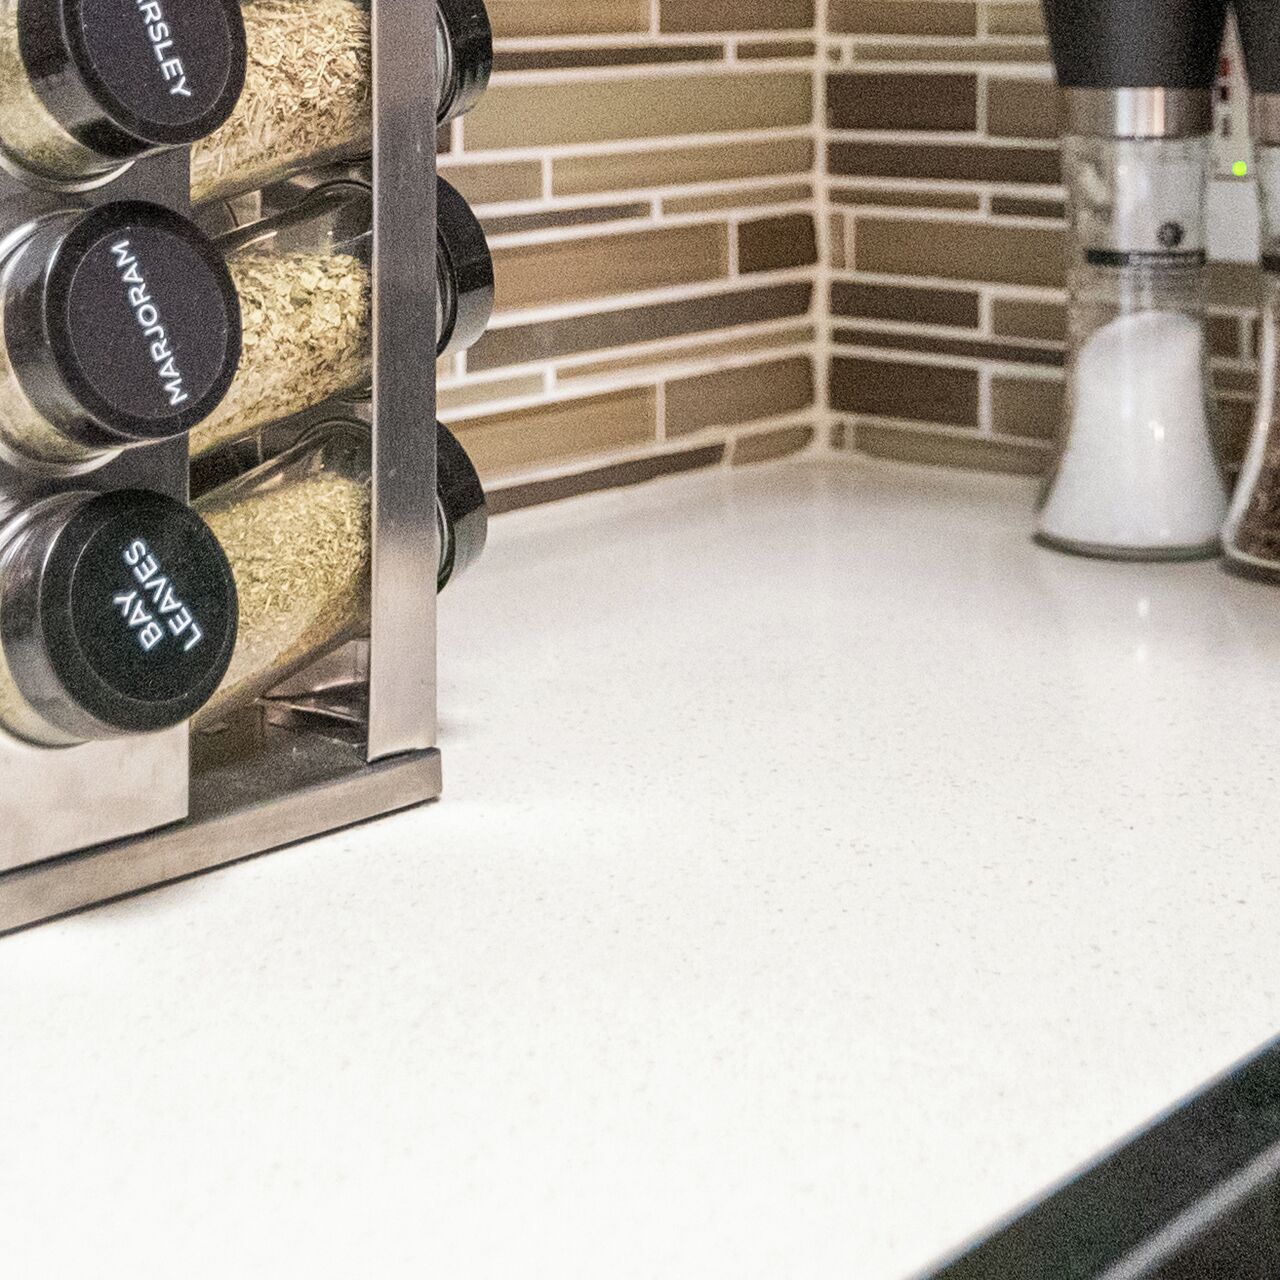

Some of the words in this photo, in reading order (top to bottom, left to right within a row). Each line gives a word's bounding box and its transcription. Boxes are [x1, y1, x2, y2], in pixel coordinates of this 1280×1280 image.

[109, 239, 190, 406] MARJORAM
[115, 593, 161, 651] BAY
[124, 538, 202, 651] LEAVES
